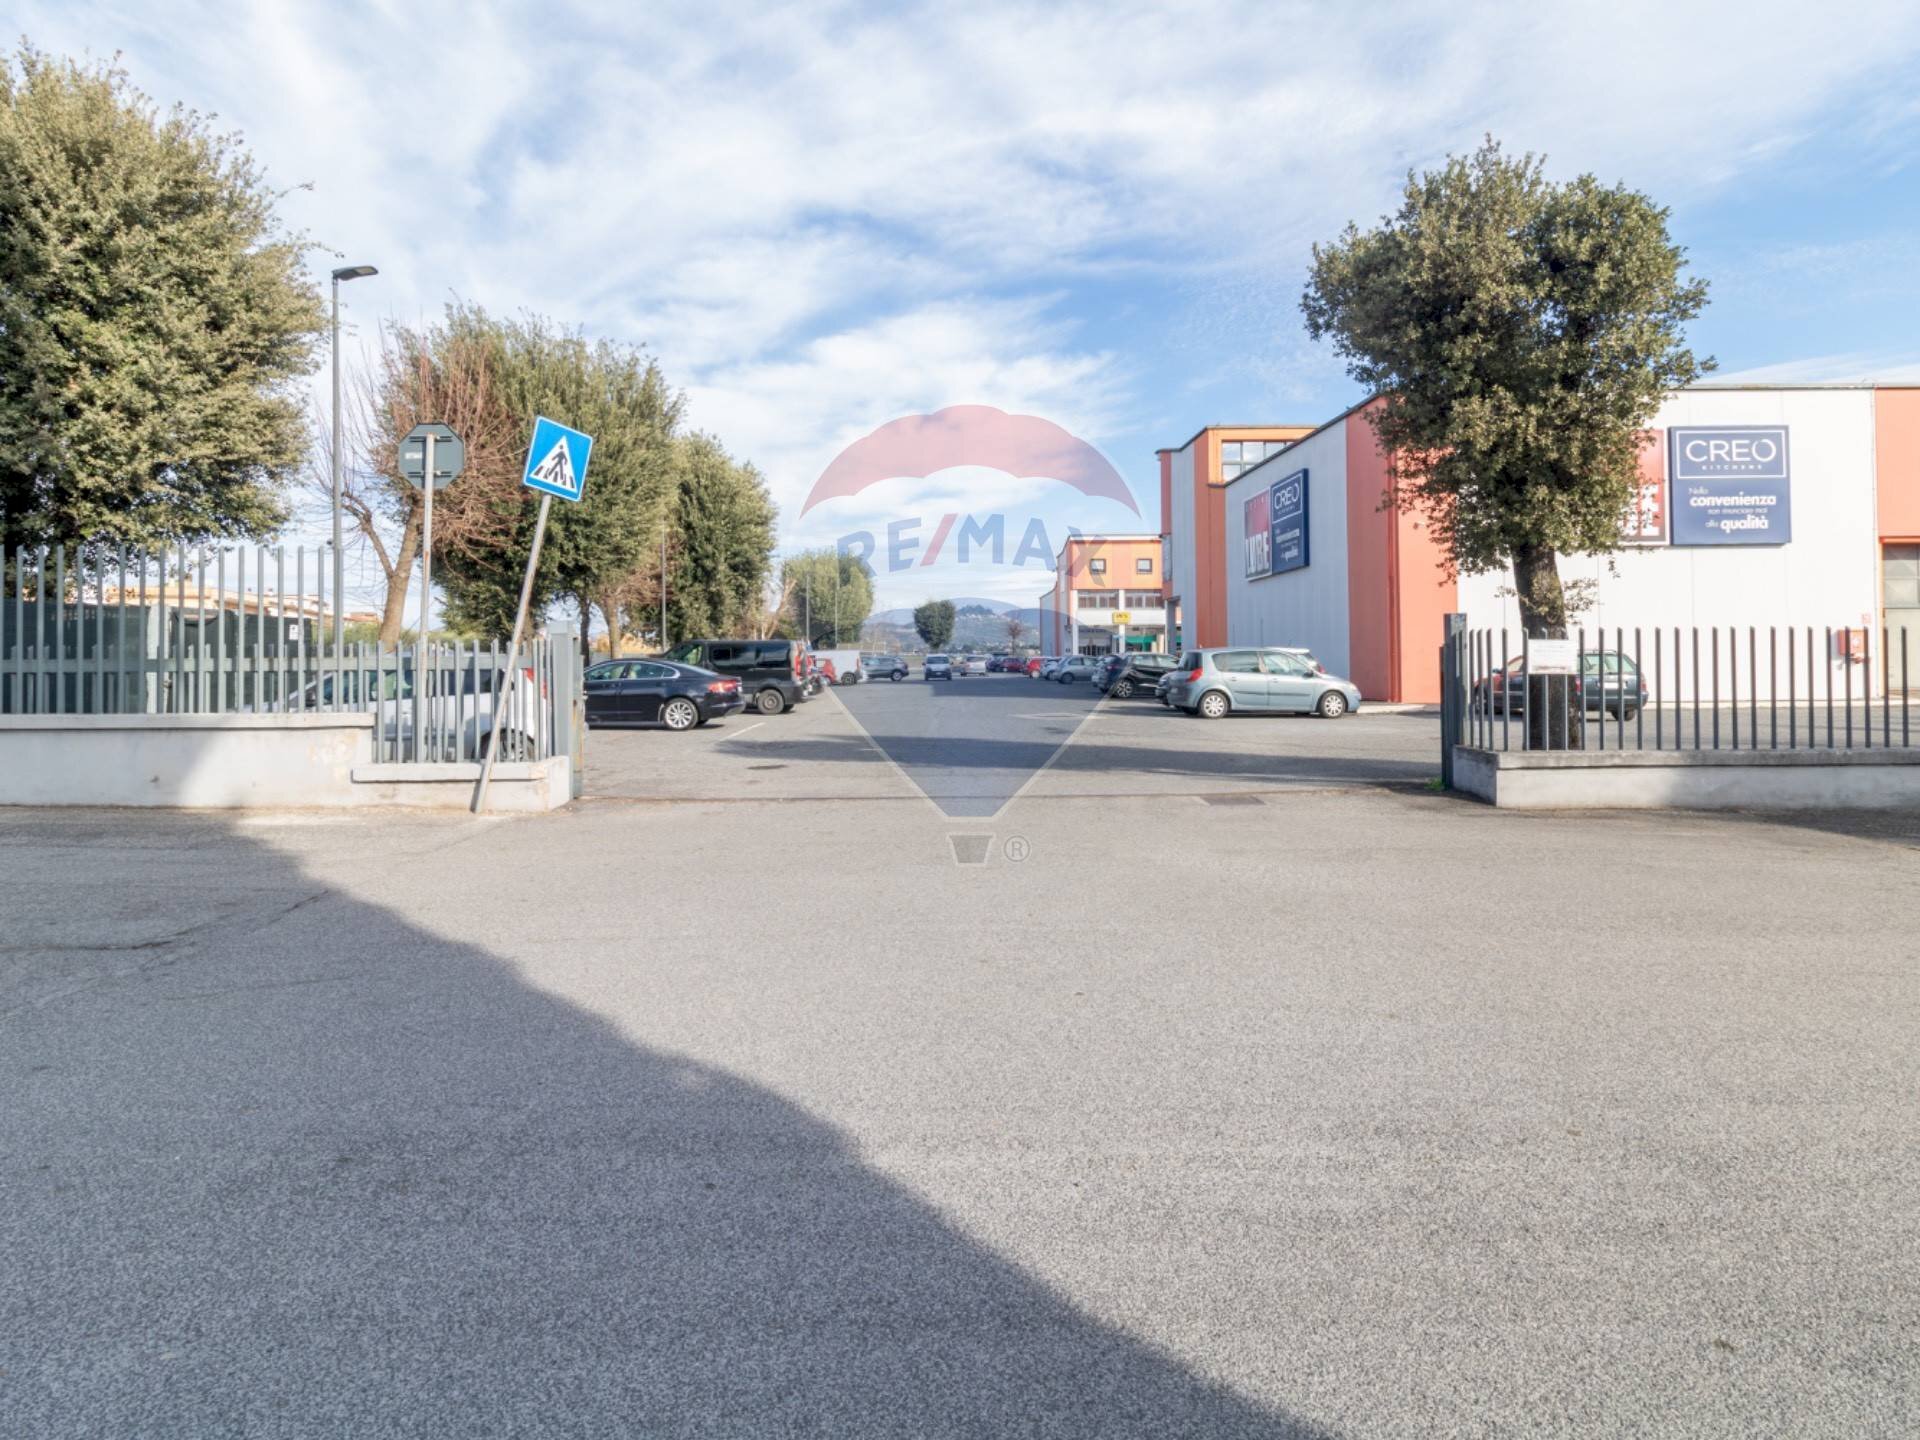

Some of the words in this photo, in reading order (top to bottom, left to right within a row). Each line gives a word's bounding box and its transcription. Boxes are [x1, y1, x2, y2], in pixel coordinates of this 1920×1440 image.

[1686, 439, 1776, 462] CREO
[1274, 483, 1299, 509] CREO
[1689, 491, 1776, 506] convenienza
[1721, 514, 1768, 533] qualità
